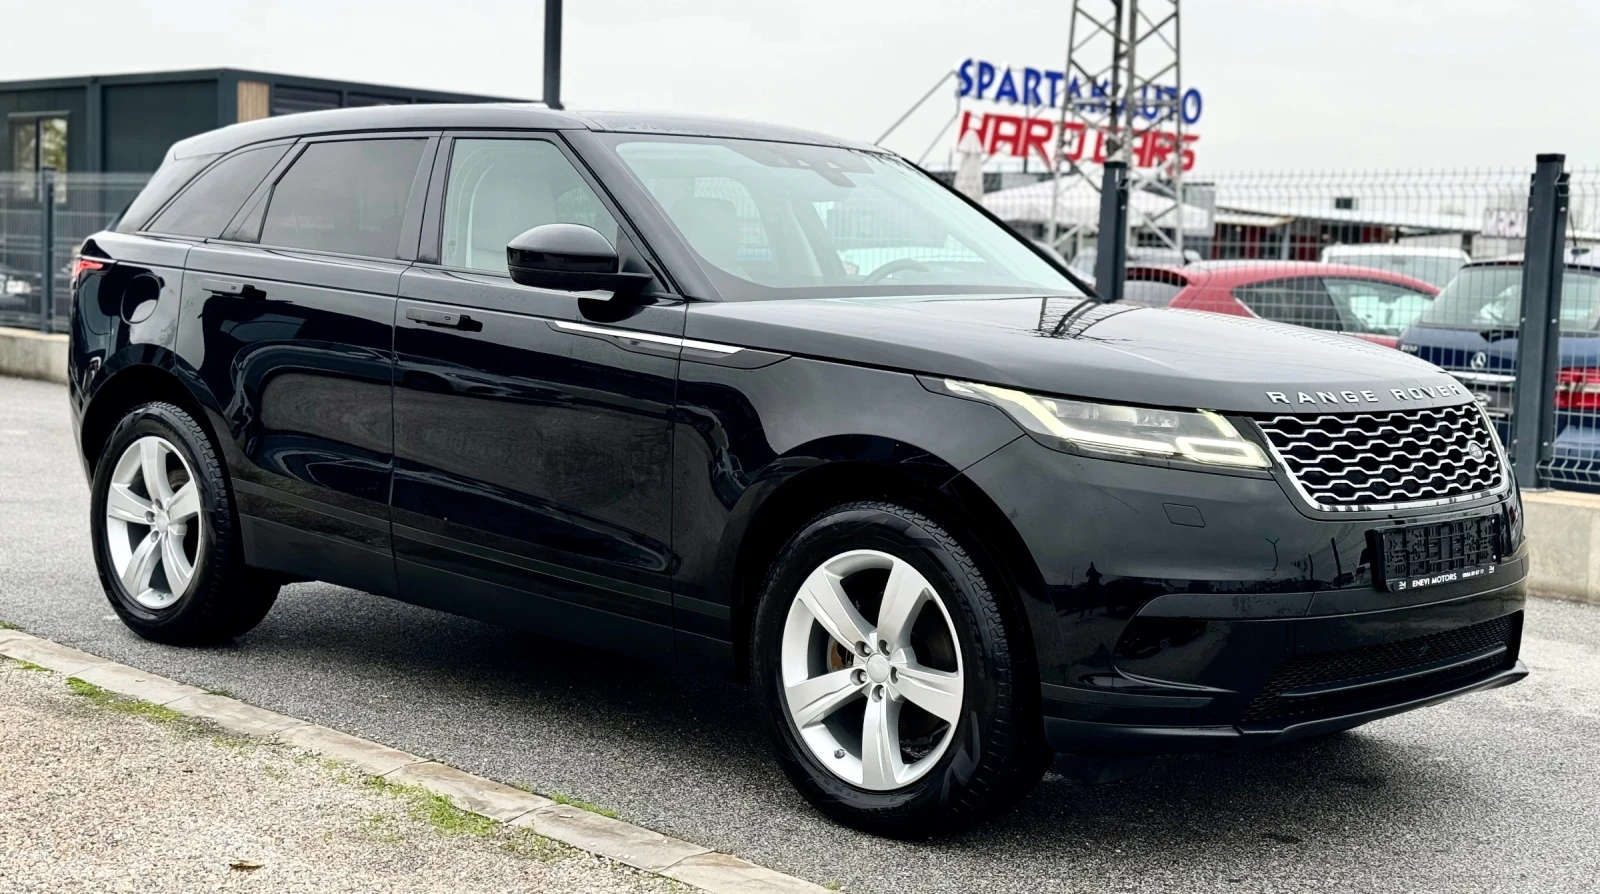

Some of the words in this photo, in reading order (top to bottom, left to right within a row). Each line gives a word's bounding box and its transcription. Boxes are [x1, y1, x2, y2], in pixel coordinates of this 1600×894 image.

[1265, 390, 1379, 404] RANGE
[1389, 384, 1462, 400] ROVER
[1412, 577, 1430, 588] ENEVI
[1431, 573, 1457, 584] MOTORS
